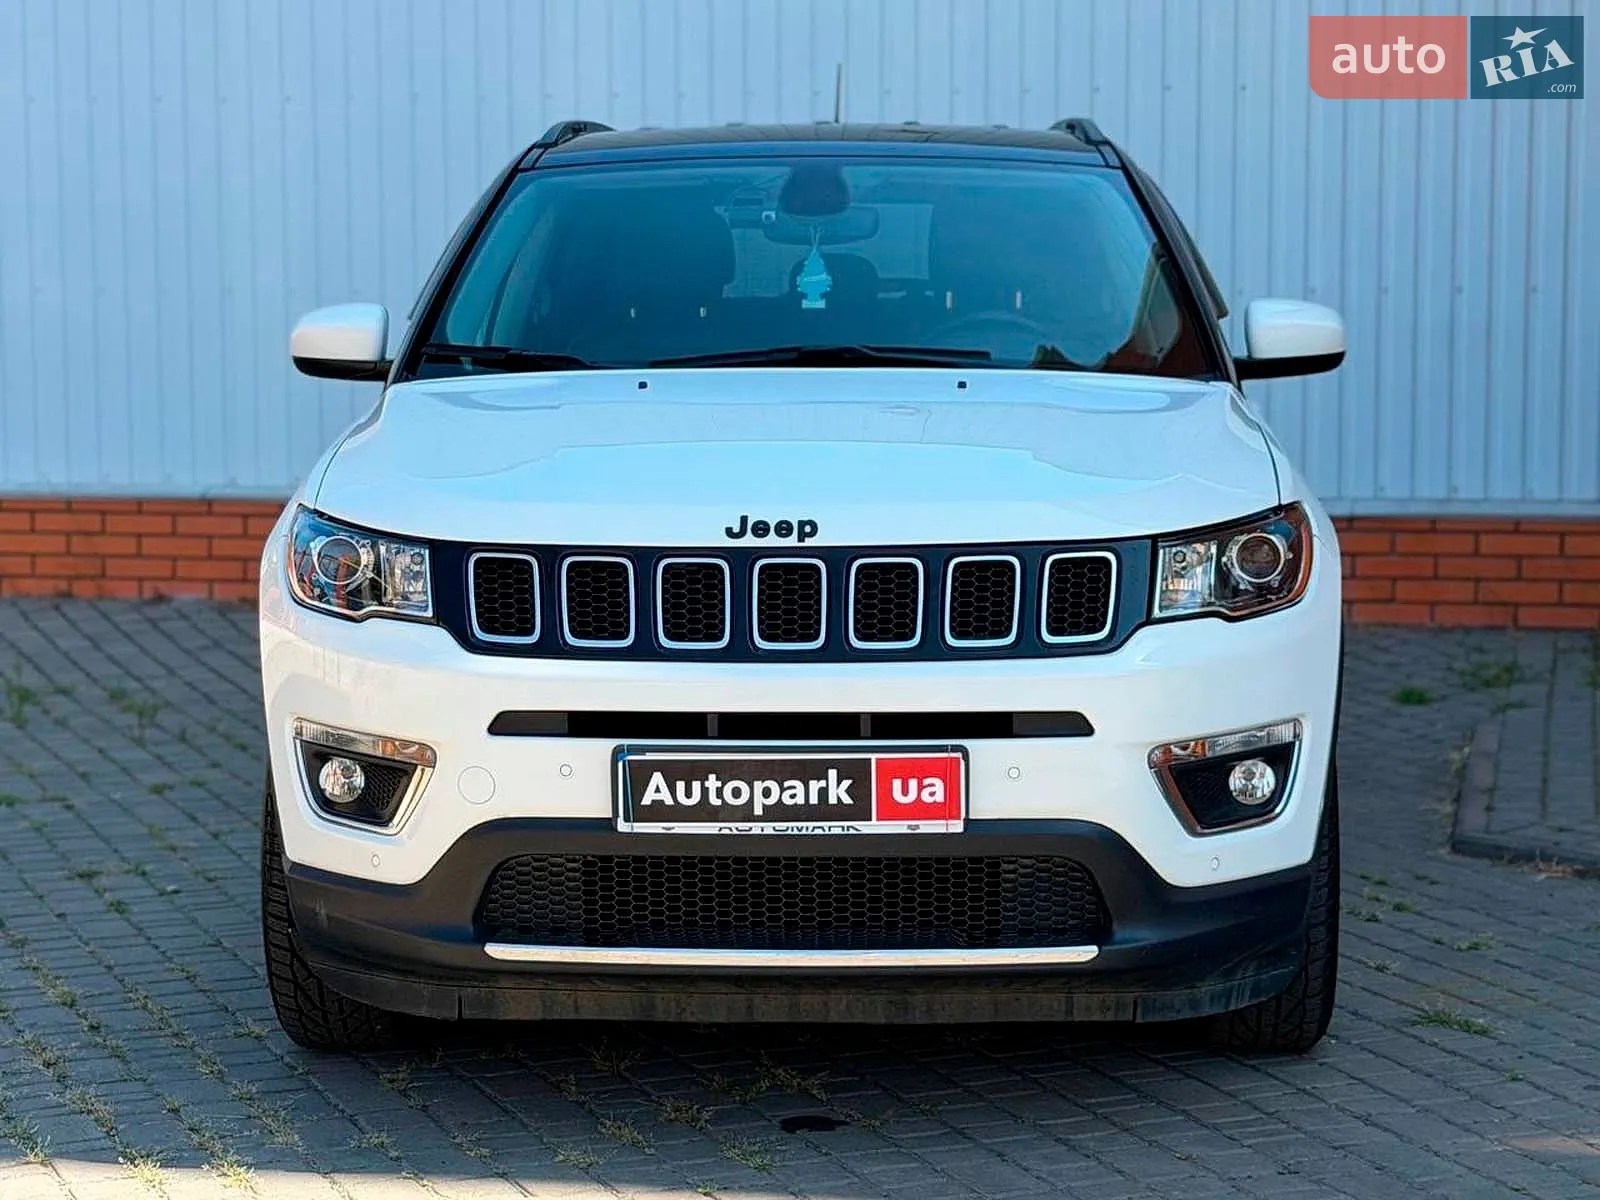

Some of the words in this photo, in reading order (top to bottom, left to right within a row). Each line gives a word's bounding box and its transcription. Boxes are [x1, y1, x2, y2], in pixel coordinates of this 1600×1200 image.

[725, 515, 818, 543] Jeep
[640, 768, 854, 816] Autopark
[892, 776, 946, 804] ua
